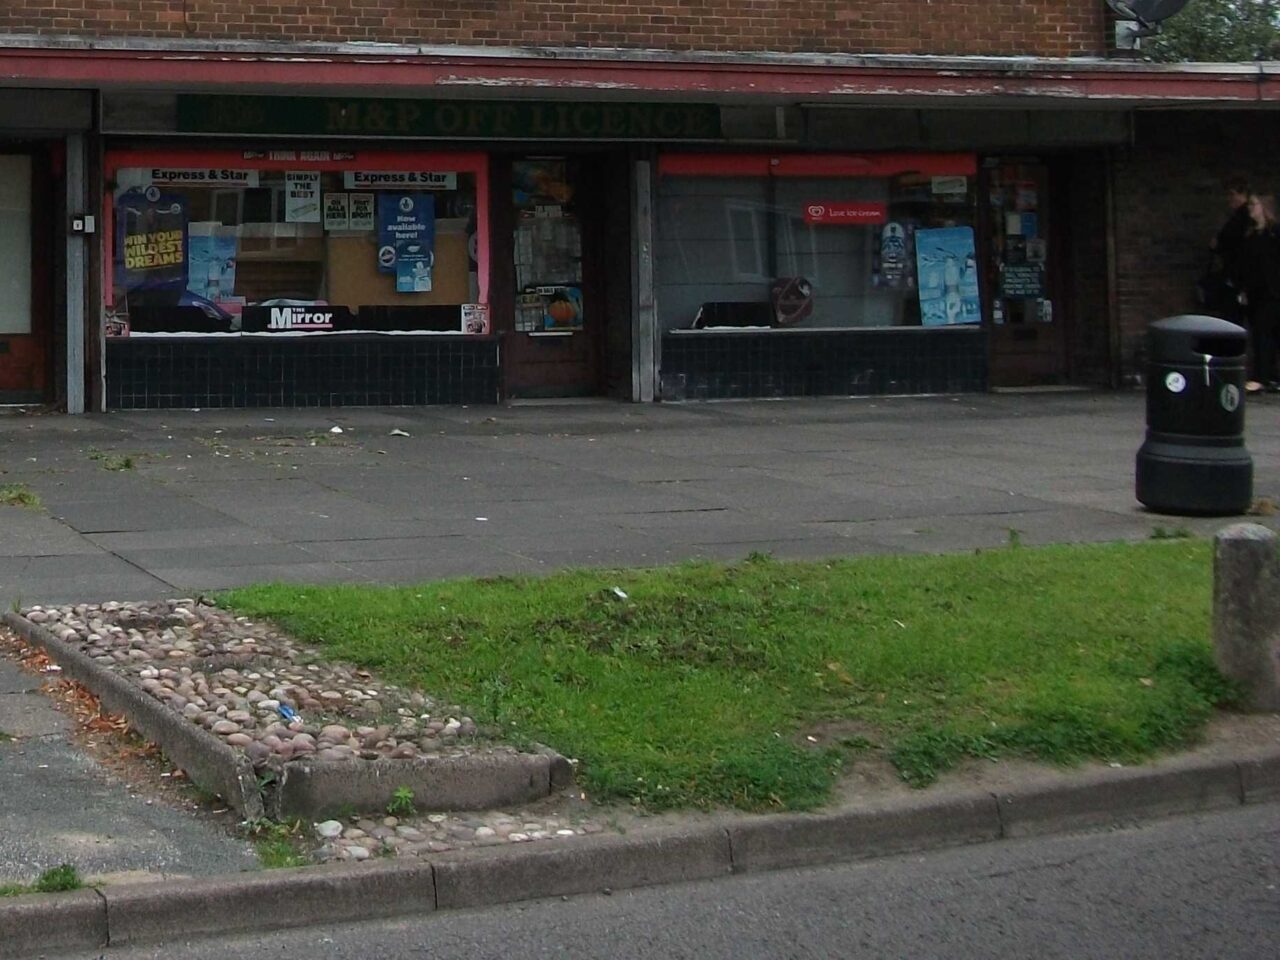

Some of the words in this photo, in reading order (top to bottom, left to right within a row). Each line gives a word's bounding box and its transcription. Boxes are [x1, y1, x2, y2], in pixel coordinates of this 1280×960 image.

[434, 103, 519, 135] OFF
[528, 104, 713, 138] LICENCE
[151, 169, 206, 182] Express
[208, 170, 217, 180] &
[219, 170, 248, 180] Star
[354, 172, 406, 184] Express
[408, 173, 417, 183] &
[420, 173, 447, 183] Star
[397, 215, 417, 223] Now
[148, 230, 183, 243] YOUR
[124, 240, 183, 257] WILDEST
[125, 251, 184, 269] DREAMS
[270, 307, 334, 329] Mirror
